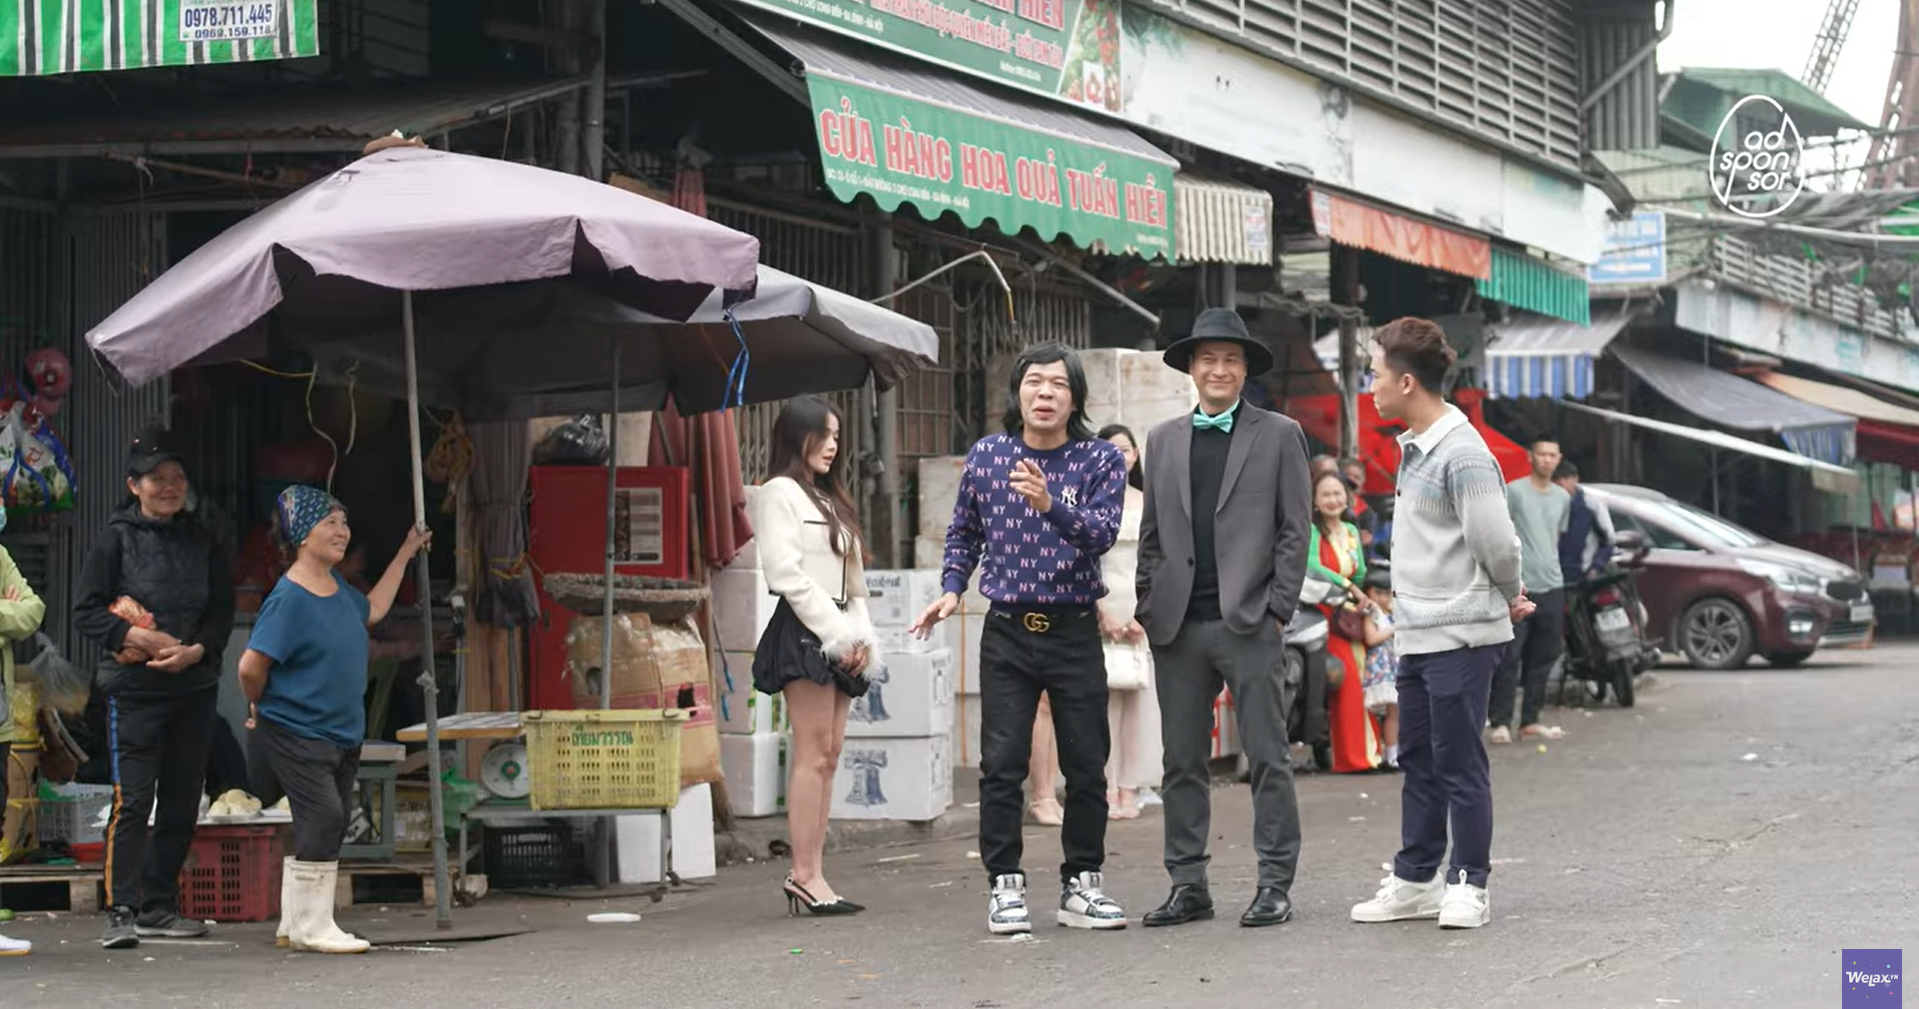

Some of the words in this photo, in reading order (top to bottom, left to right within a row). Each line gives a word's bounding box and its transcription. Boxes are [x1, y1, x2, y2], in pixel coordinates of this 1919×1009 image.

[185, 4, 272, 28] 0978.711.445
[820, 96, 878, 168] CỬA
[884, 115, 953, 183] HÀNG
[960, 142, 1012, 196] HOA
[1016, 148, 1062, 207] QUẢ
[1066, 161, 1120, 220] TUẤN
[1124, 172, 1167, 230] HIỀN
[977, 442, 994, 452] NY
[994, 456, 1011, 465] NY
[976, 467, 992, 477] NY
[1047, 472, 1065, 482] NY
[992, 480, 1008, 489] NY
[1008, 493, 1025, 503] NY
[1006, 518, 1022, 529] NY
[1023, 533, 1040, 543] NY
[1005, 544, 1021, 553] NY
[1041, 548, 1057, 557] NY
[1020, 558, 1037, 568] NY
[1057, 560, 1074, 570] NY
[1038, 571, 1055, 580] NY
[1020, 582, 1036, 592] NY
[1056, 584, 1073, 593] NY
